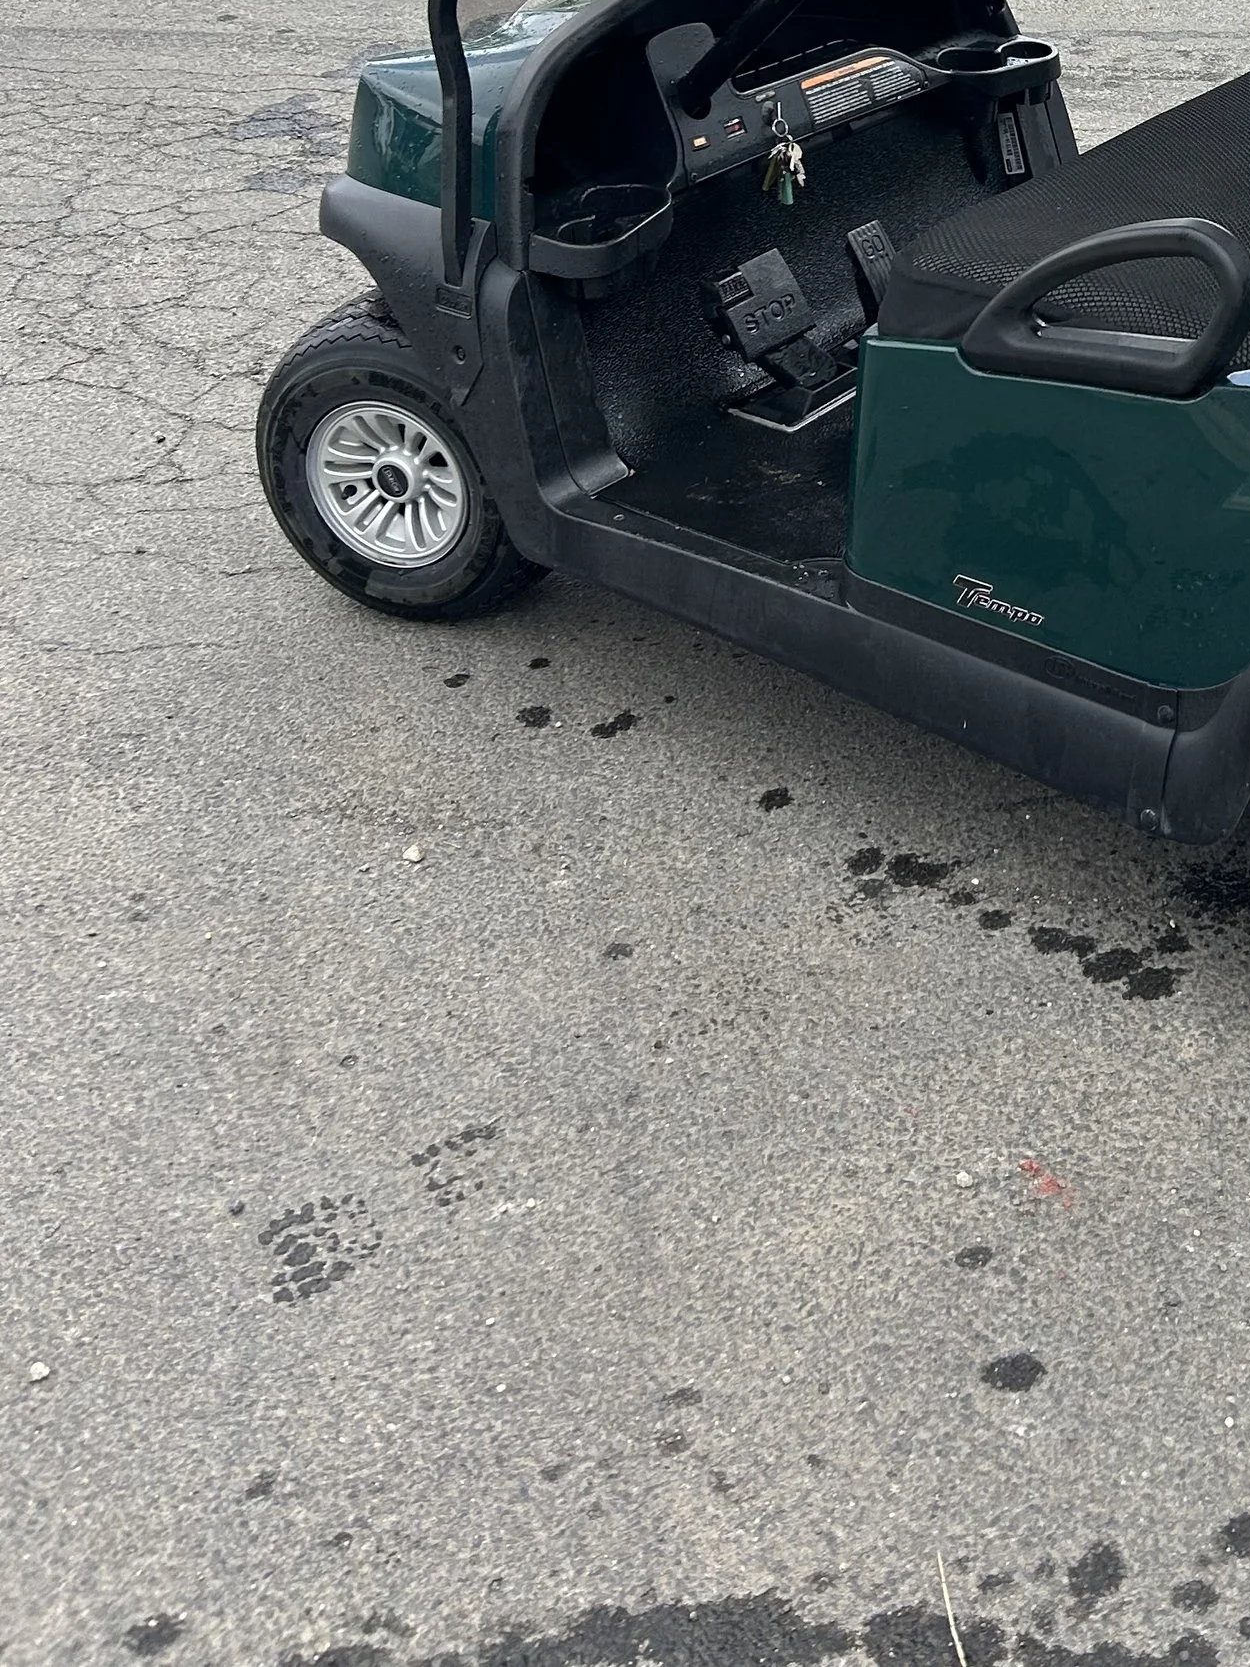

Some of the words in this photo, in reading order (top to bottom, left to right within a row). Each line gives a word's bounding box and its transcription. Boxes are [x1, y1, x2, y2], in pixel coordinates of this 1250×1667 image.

[861, 234, 886, 260] GO
[743, 293, 796, 334] STOP
[953, 574, 1045, 626] Tempo
